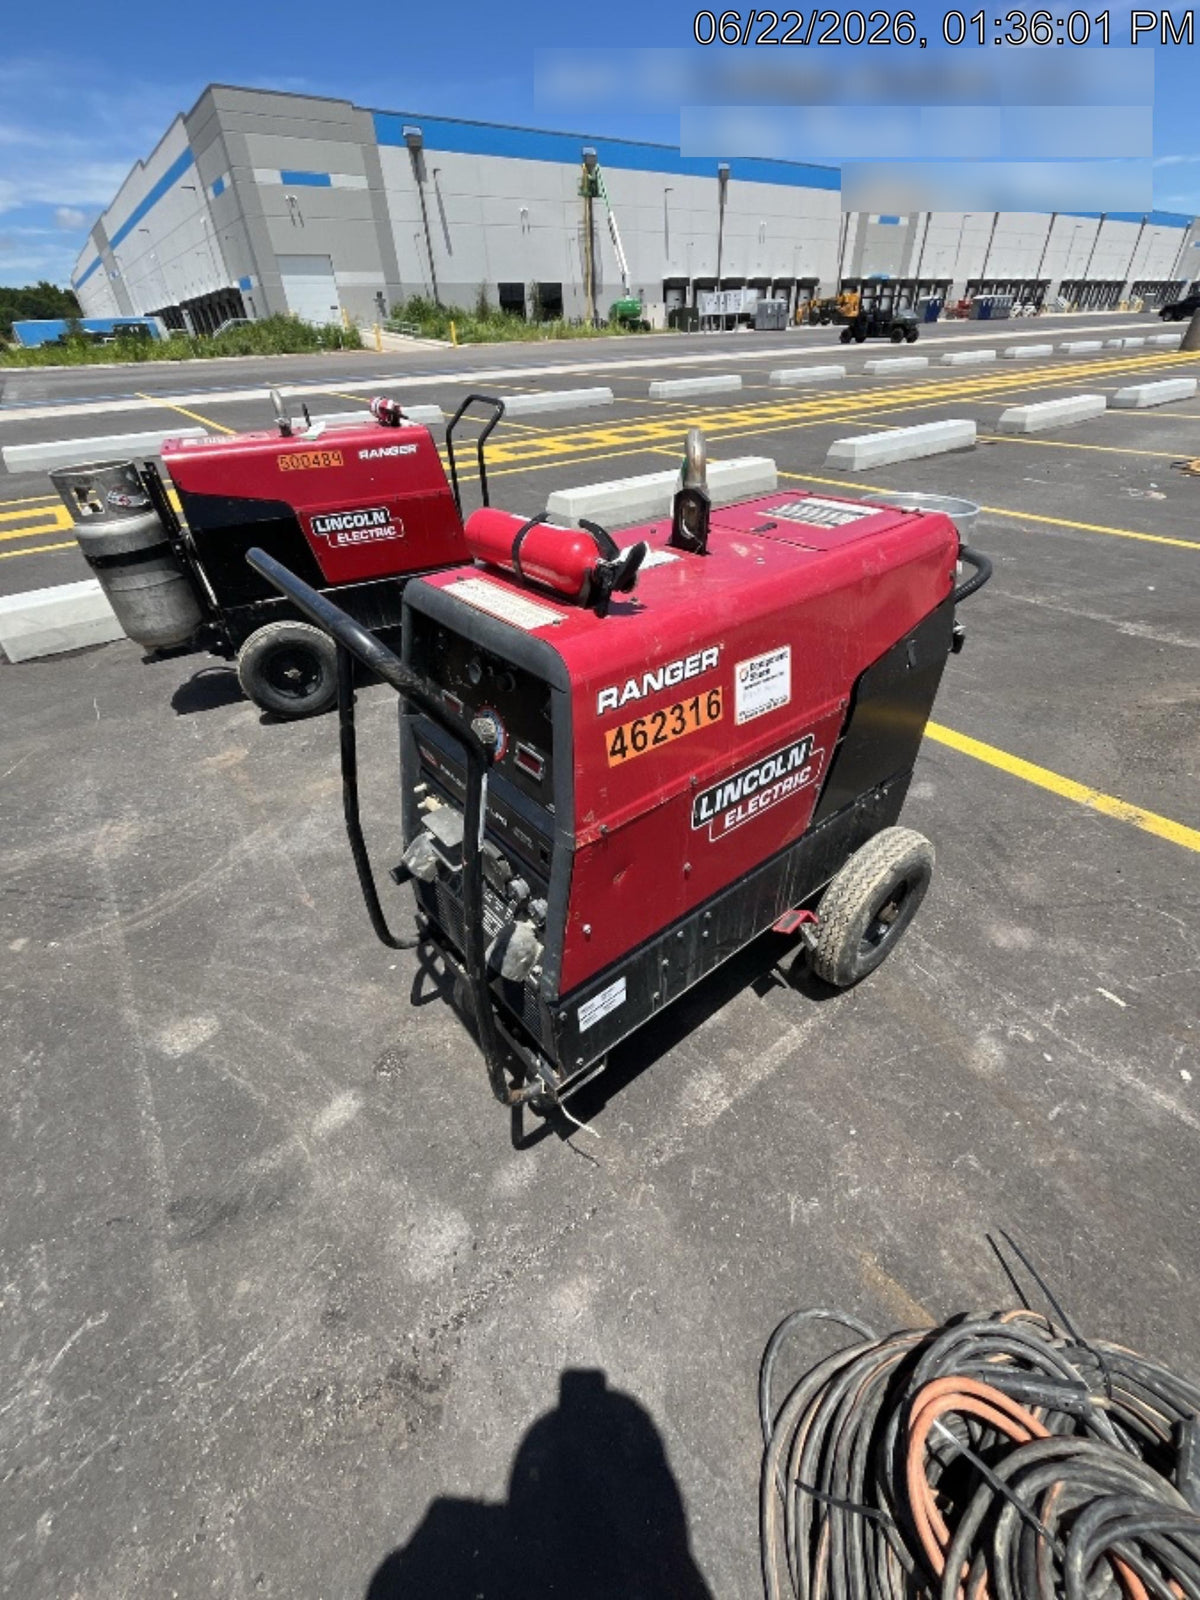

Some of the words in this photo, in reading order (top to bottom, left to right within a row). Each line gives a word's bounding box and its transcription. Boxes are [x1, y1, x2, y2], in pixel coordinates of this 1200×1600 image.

[358, 444, 418, 460] RANGER
[315, 511, 387, 533] LINCOLN
[336, 525, 398, 543] ELECTRIC
[596, 645, 720, 716] RANGER
[608, 688, 722, 759] 462316
[699, 741, 807, 822] LINCOLN
[723, 765, 812, 830] ELECTRIC
